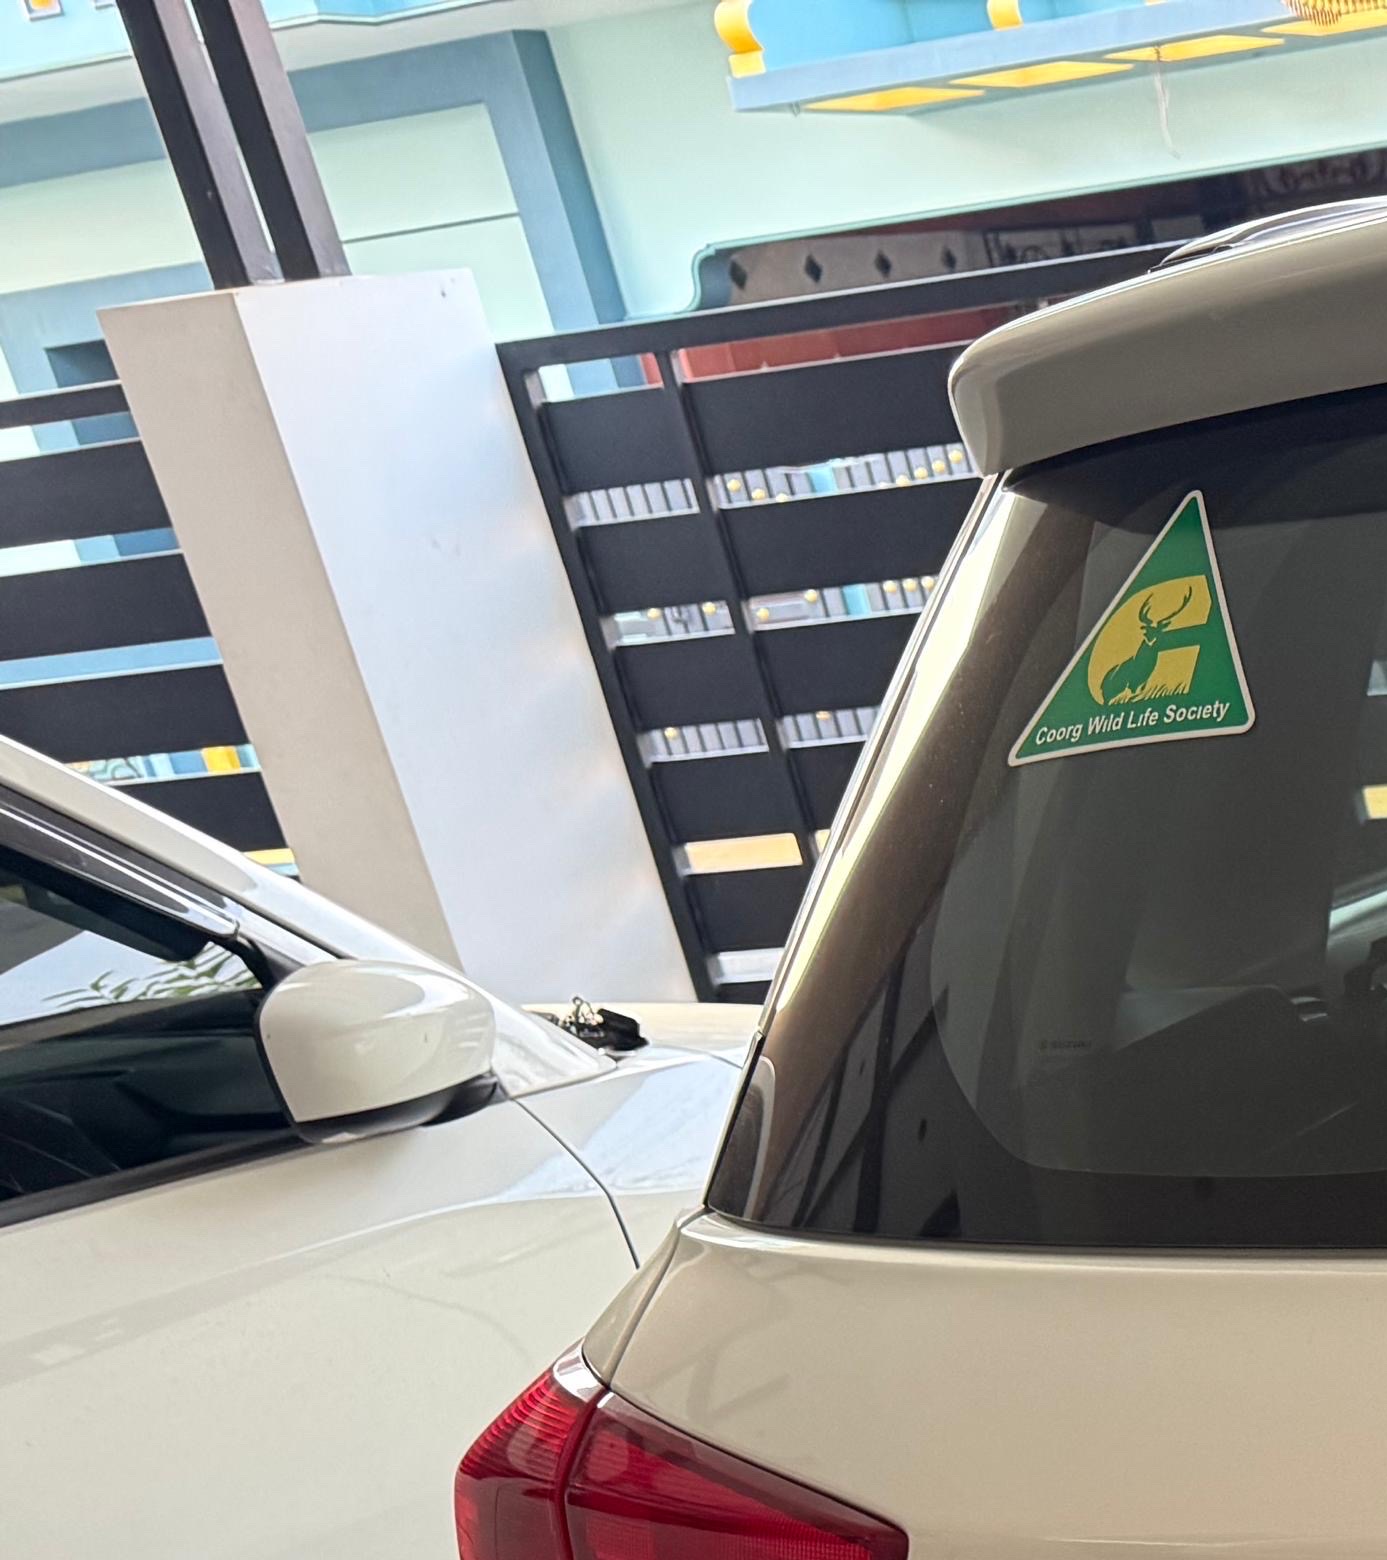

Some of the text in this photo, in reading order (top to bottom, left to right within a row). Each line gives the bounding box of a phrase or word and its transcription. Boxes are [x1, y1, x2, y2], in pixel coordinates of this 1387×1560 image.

[1035, 700, 1230, 745] Coorg Wild Life Society
